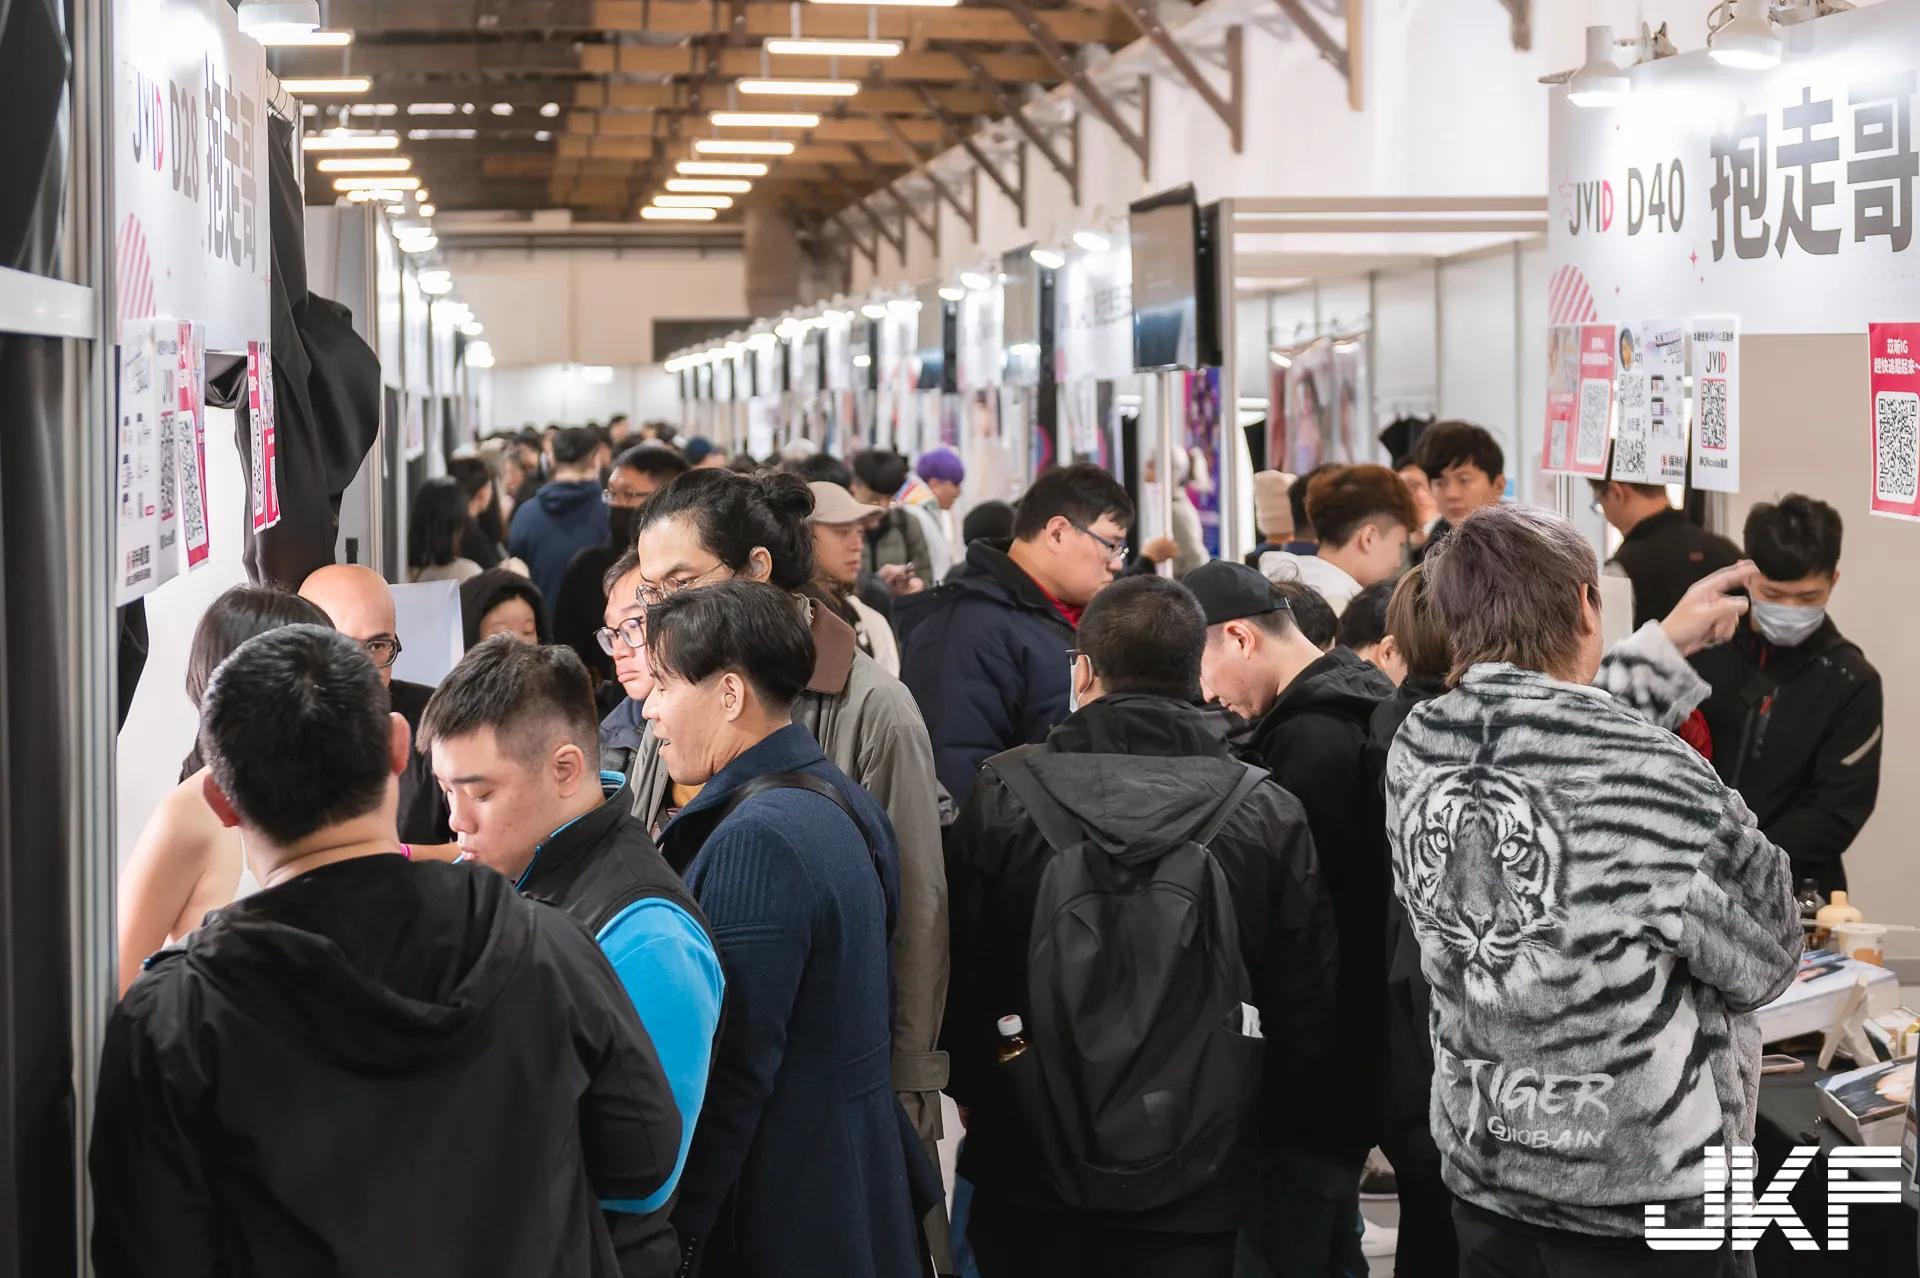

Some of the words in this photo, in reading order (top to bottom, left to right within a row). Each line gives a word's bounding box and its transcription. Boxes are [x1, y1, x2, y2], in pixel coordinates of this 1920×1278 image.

[169, 79, 199, 203] D28
[204, 50, 257, 273] 抱走哥
[1568, 179, 1614, 236] JVID
[1627, 157, 1685, 236] D40
[1710, 69, 1919, 262] 抱走哥
[1705, 351, 1727, 373] JVID
[1460, 1059, 1615, 1147] TIGER
